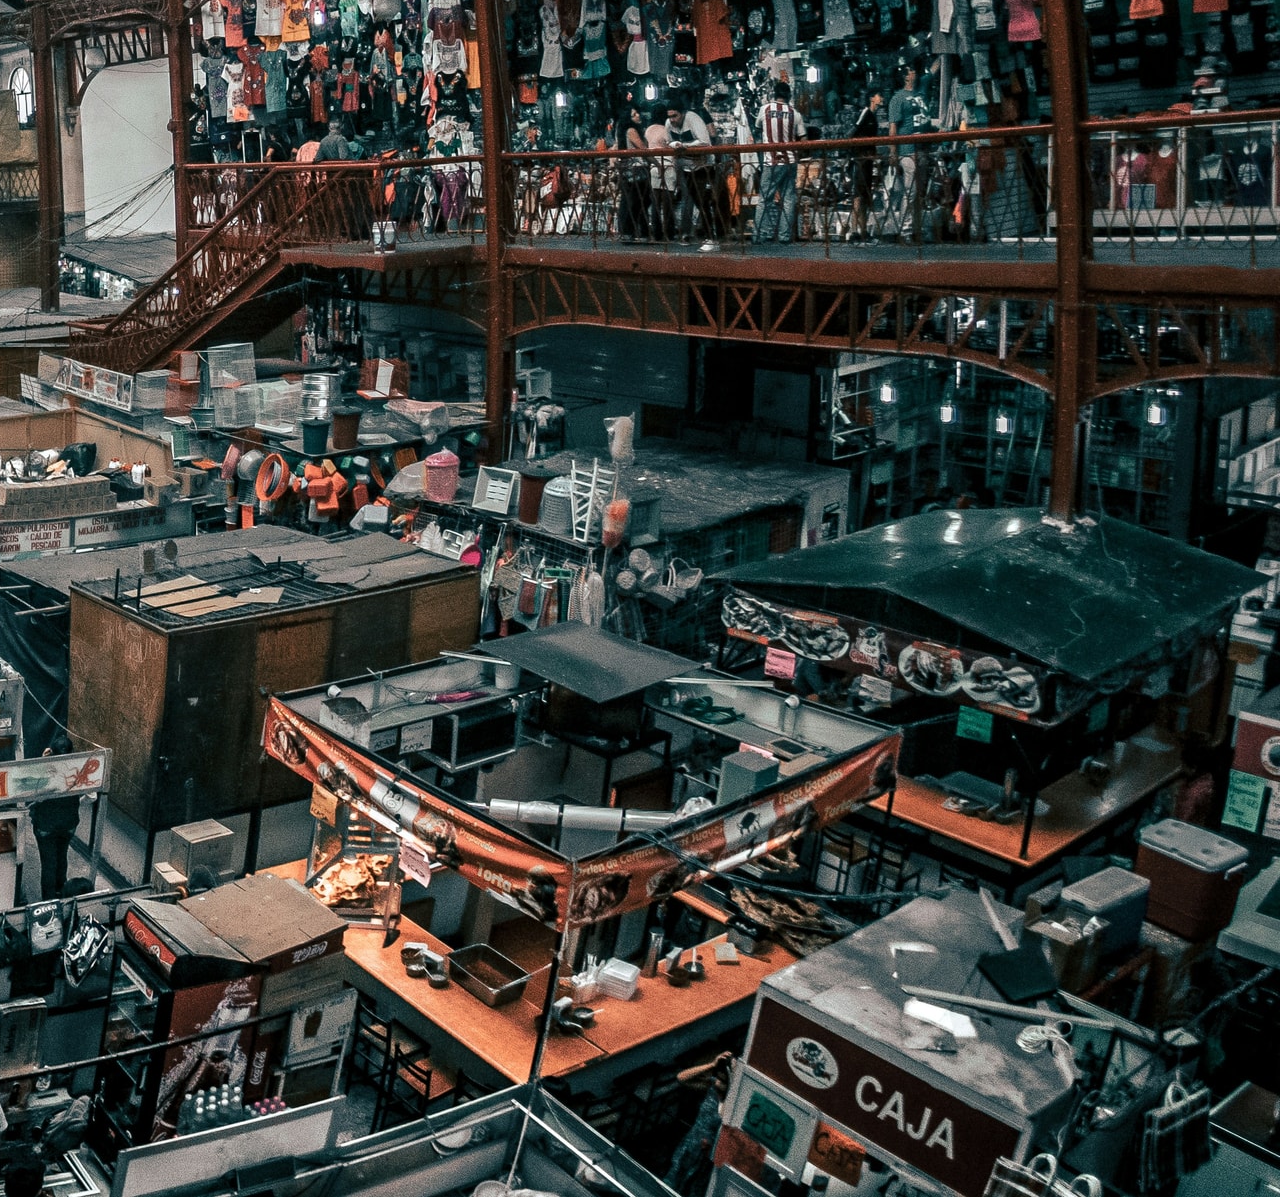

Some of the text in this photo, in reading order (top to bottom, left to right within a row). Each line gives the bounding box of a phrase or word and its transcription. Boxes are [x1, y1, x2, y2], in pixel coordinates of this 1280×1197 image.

[27, 523, 47, 532] PULPO
[78, 525, 110, 536] MOJARRA
[30, 531, 63, 541] CALDO DE
[30, 540, 61, 550] PESCADO
[854, 1074, 956, 1161] CAJA
[746, 1103, 789, 1144] CAJA
